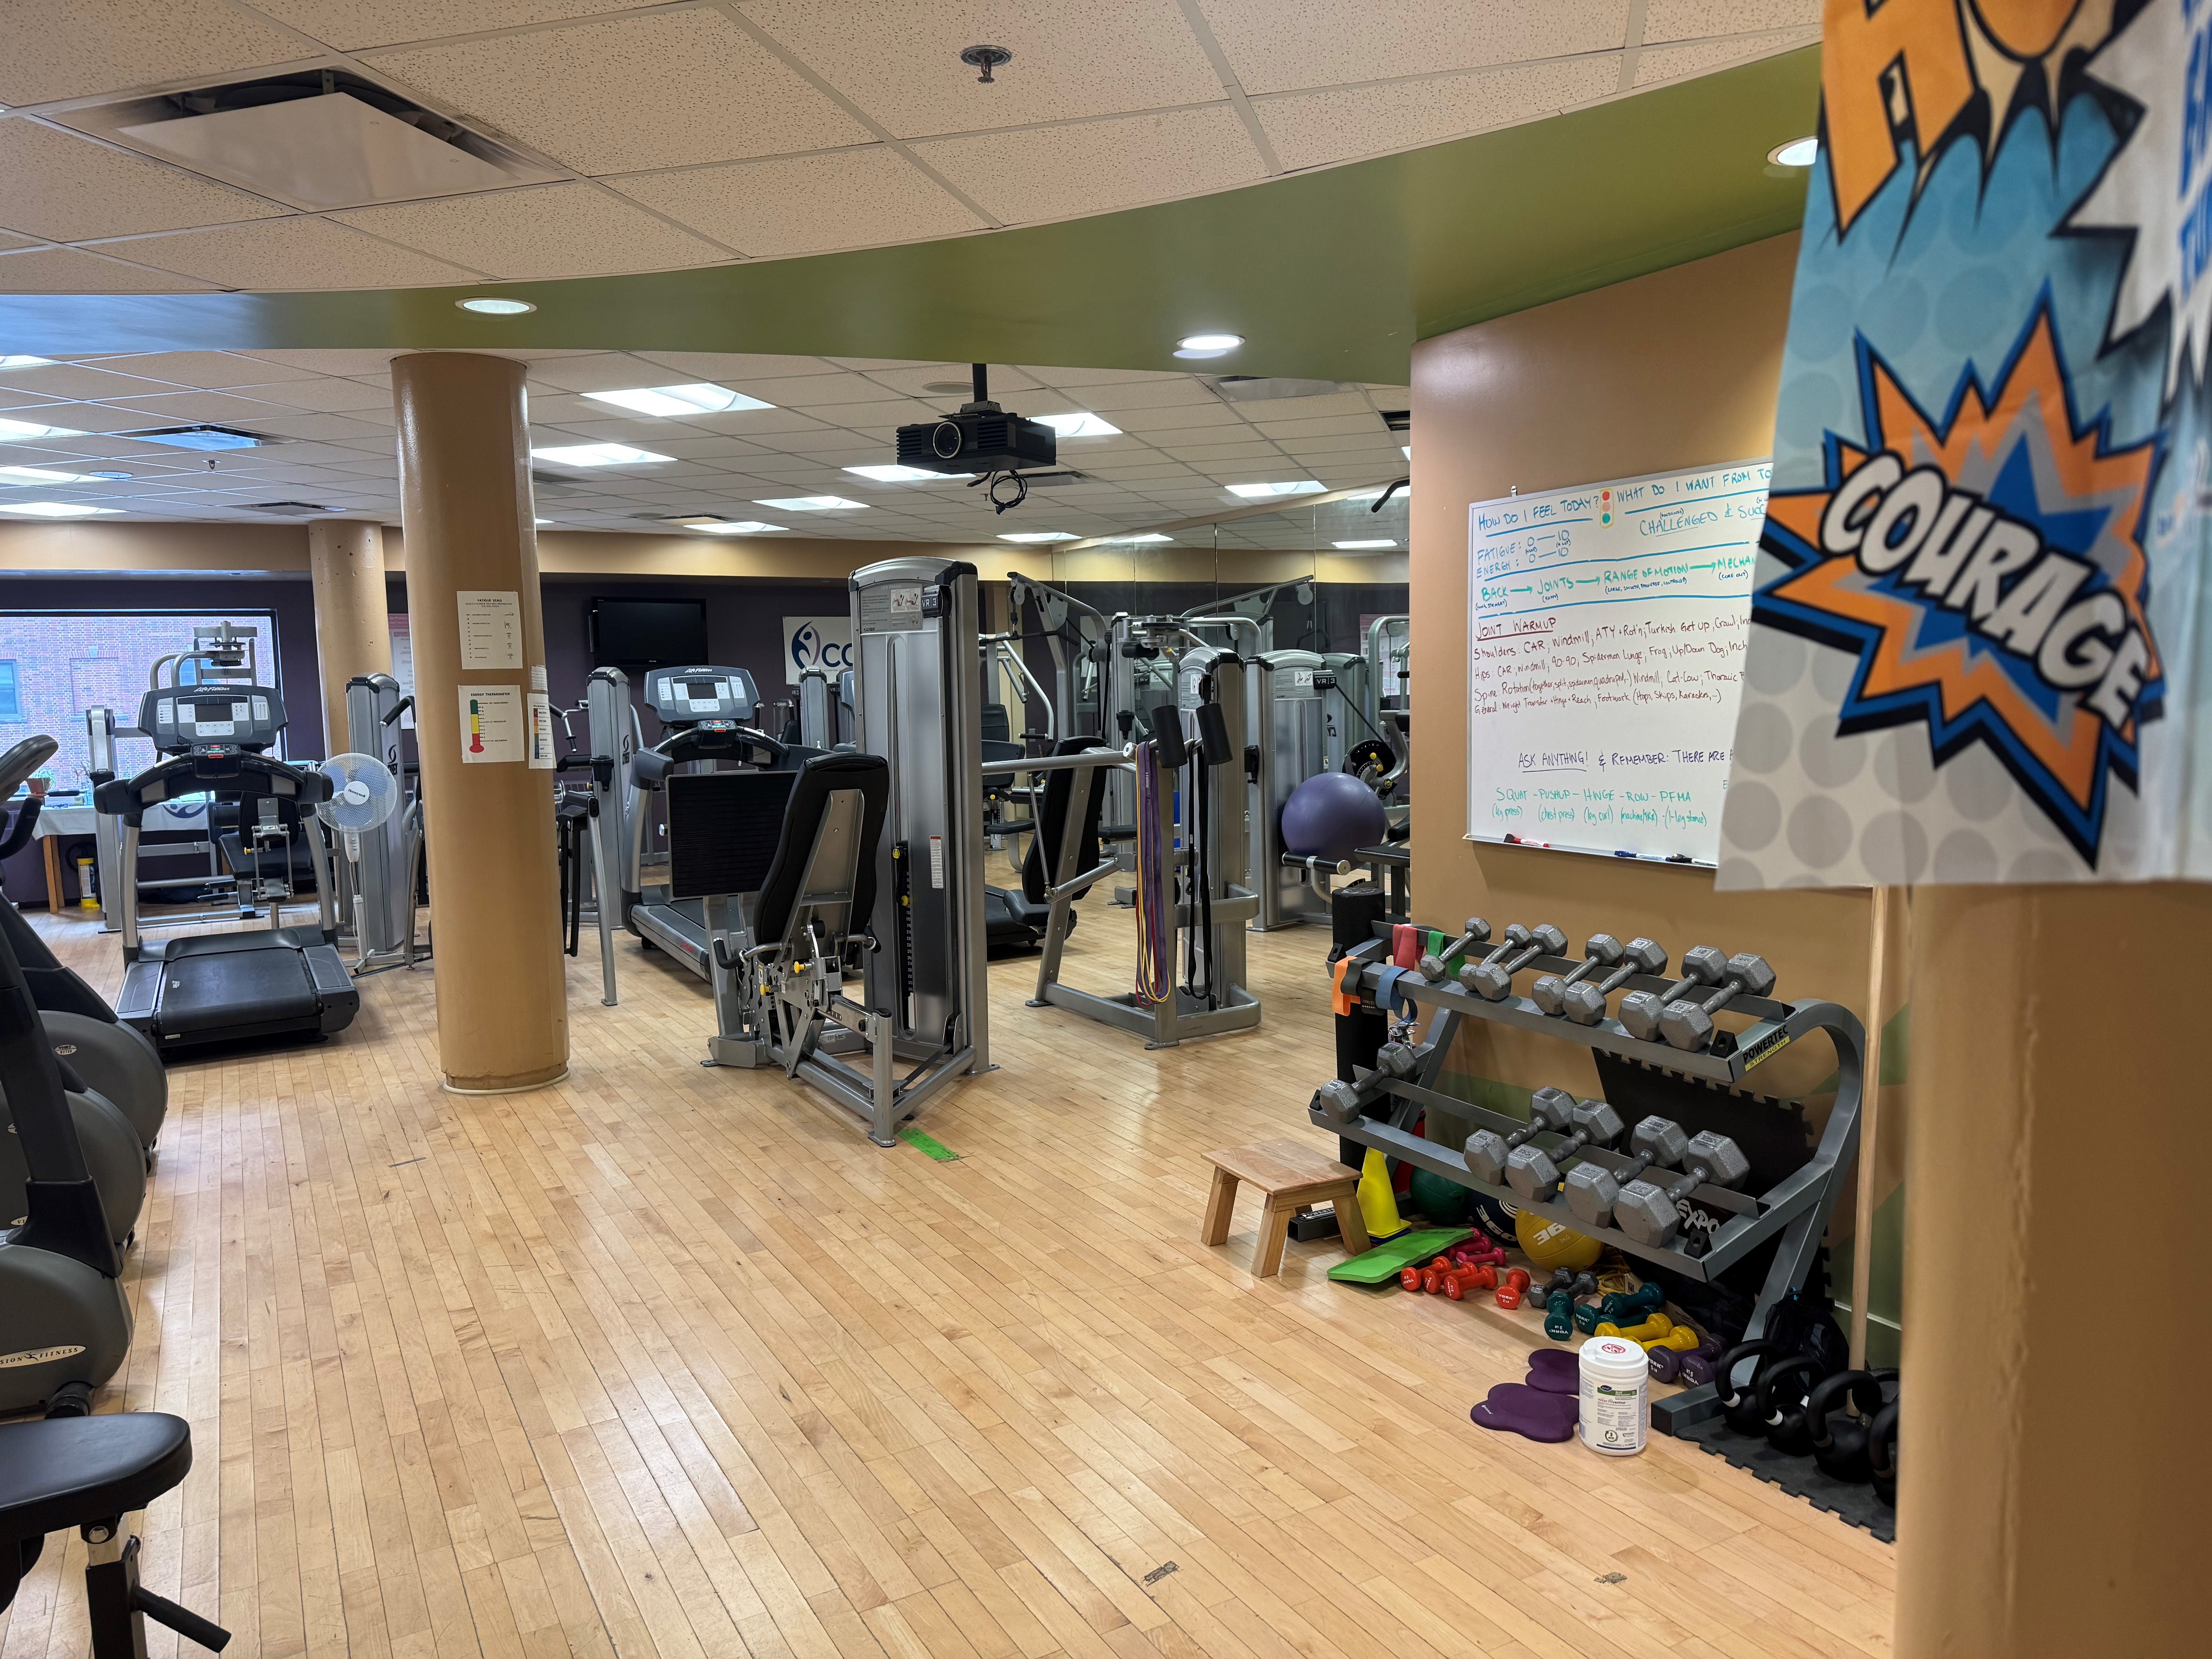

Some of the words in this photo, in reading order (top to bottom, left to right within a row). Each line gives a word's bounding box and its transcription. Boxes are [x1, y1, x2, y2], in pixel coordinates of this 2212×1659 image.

[1617, 486, 1644, 503] WHAT
[1651, 484, 1664, 496] DO
[1676, 481, 1679, 492] I
[1686, 476, 1714, 491] WANT
[1723, 471, 1751, 487] FROM
[1479, 513, 1500, 531] HOW
[1503, 513, 1518, 524] DO
[1524, 509, 1527, 522] I
[1533, 505, 1556, 519] FEEL
[1640, 511, 1718, 536] CHALLENGED
[1481, 586, 1509, 602] BACK
[1537, 577, 1574, 595] JOINTS
[1604, 569, 1638, 584] RANGE
[1642, 568, 1653, 578] OF
[1654, 562, 1688, 576] MOTION
[1823, 454, 2150, 728] COURAGE
[1475, 622, 1502, 639] JOINT
[1513, 617, 1556, 633] WARMUP
[1645, 621, 1676, 634] Turkish
[1680, 621, 1696, 632] Get
[1582, 651, 1620, 665] Spiderman
[1704, 670, 1738, 682] Thoracic
[1502, 701, 1522, 713] Weight
[1598, 692, 1631, 702] Footwork
[1518, 752, 1536, 768] ASK
[1611, 752, 1669, 766] REMEMBER:
[1671, 749, 1704, 763] THERE
[1708, 750, 1724, 762] ARE
[1496, 787, 1528, 802] SQUAT
[1625, 791, 1649, 802] ROW
[1659, 791, 1692, 802] PFMA
[1743, 1024, 1788, 1064] POWERTEC
[1750, 1039, 1786, 1067] STRENGTH
[40, 1347, 78, 1358] FITNESS
